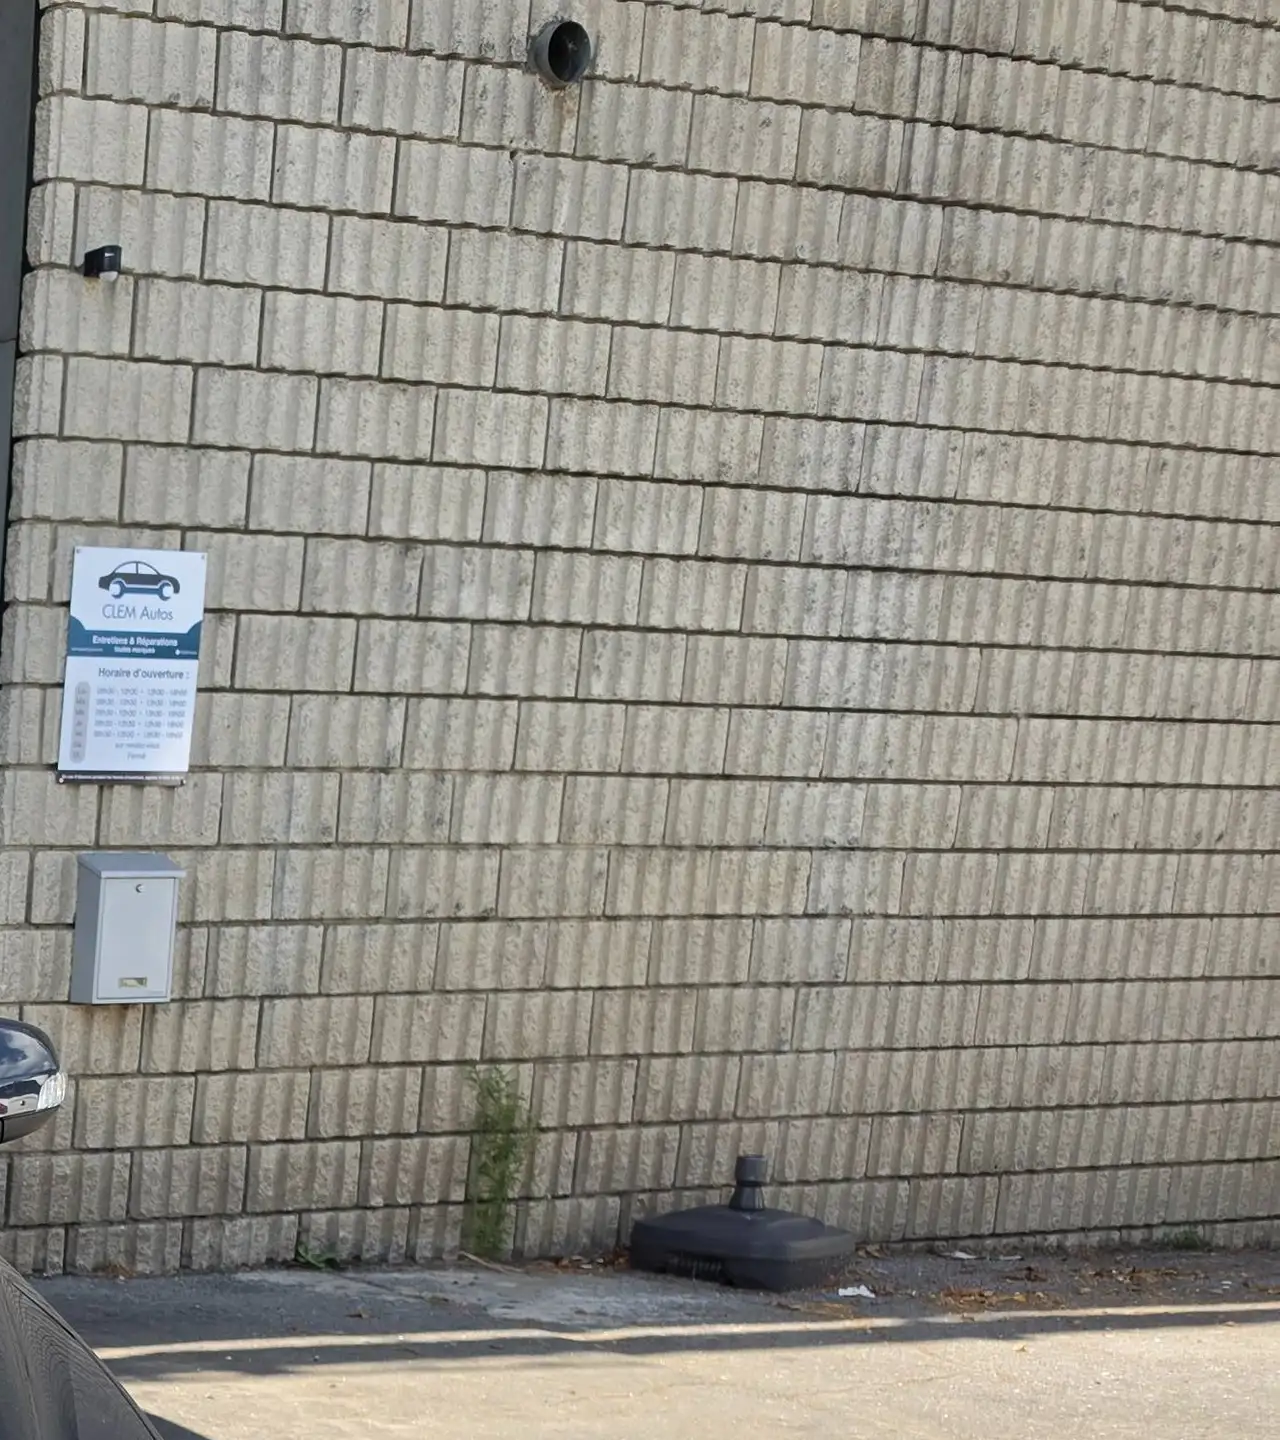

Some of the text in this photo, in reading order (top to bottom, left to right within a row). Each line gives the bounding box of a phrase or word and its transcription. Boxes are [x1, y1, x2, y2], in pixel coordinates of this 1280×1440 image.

[102, 604, 174, 621] CLEM Autos
[98, 667, 131, 678] Horaire
